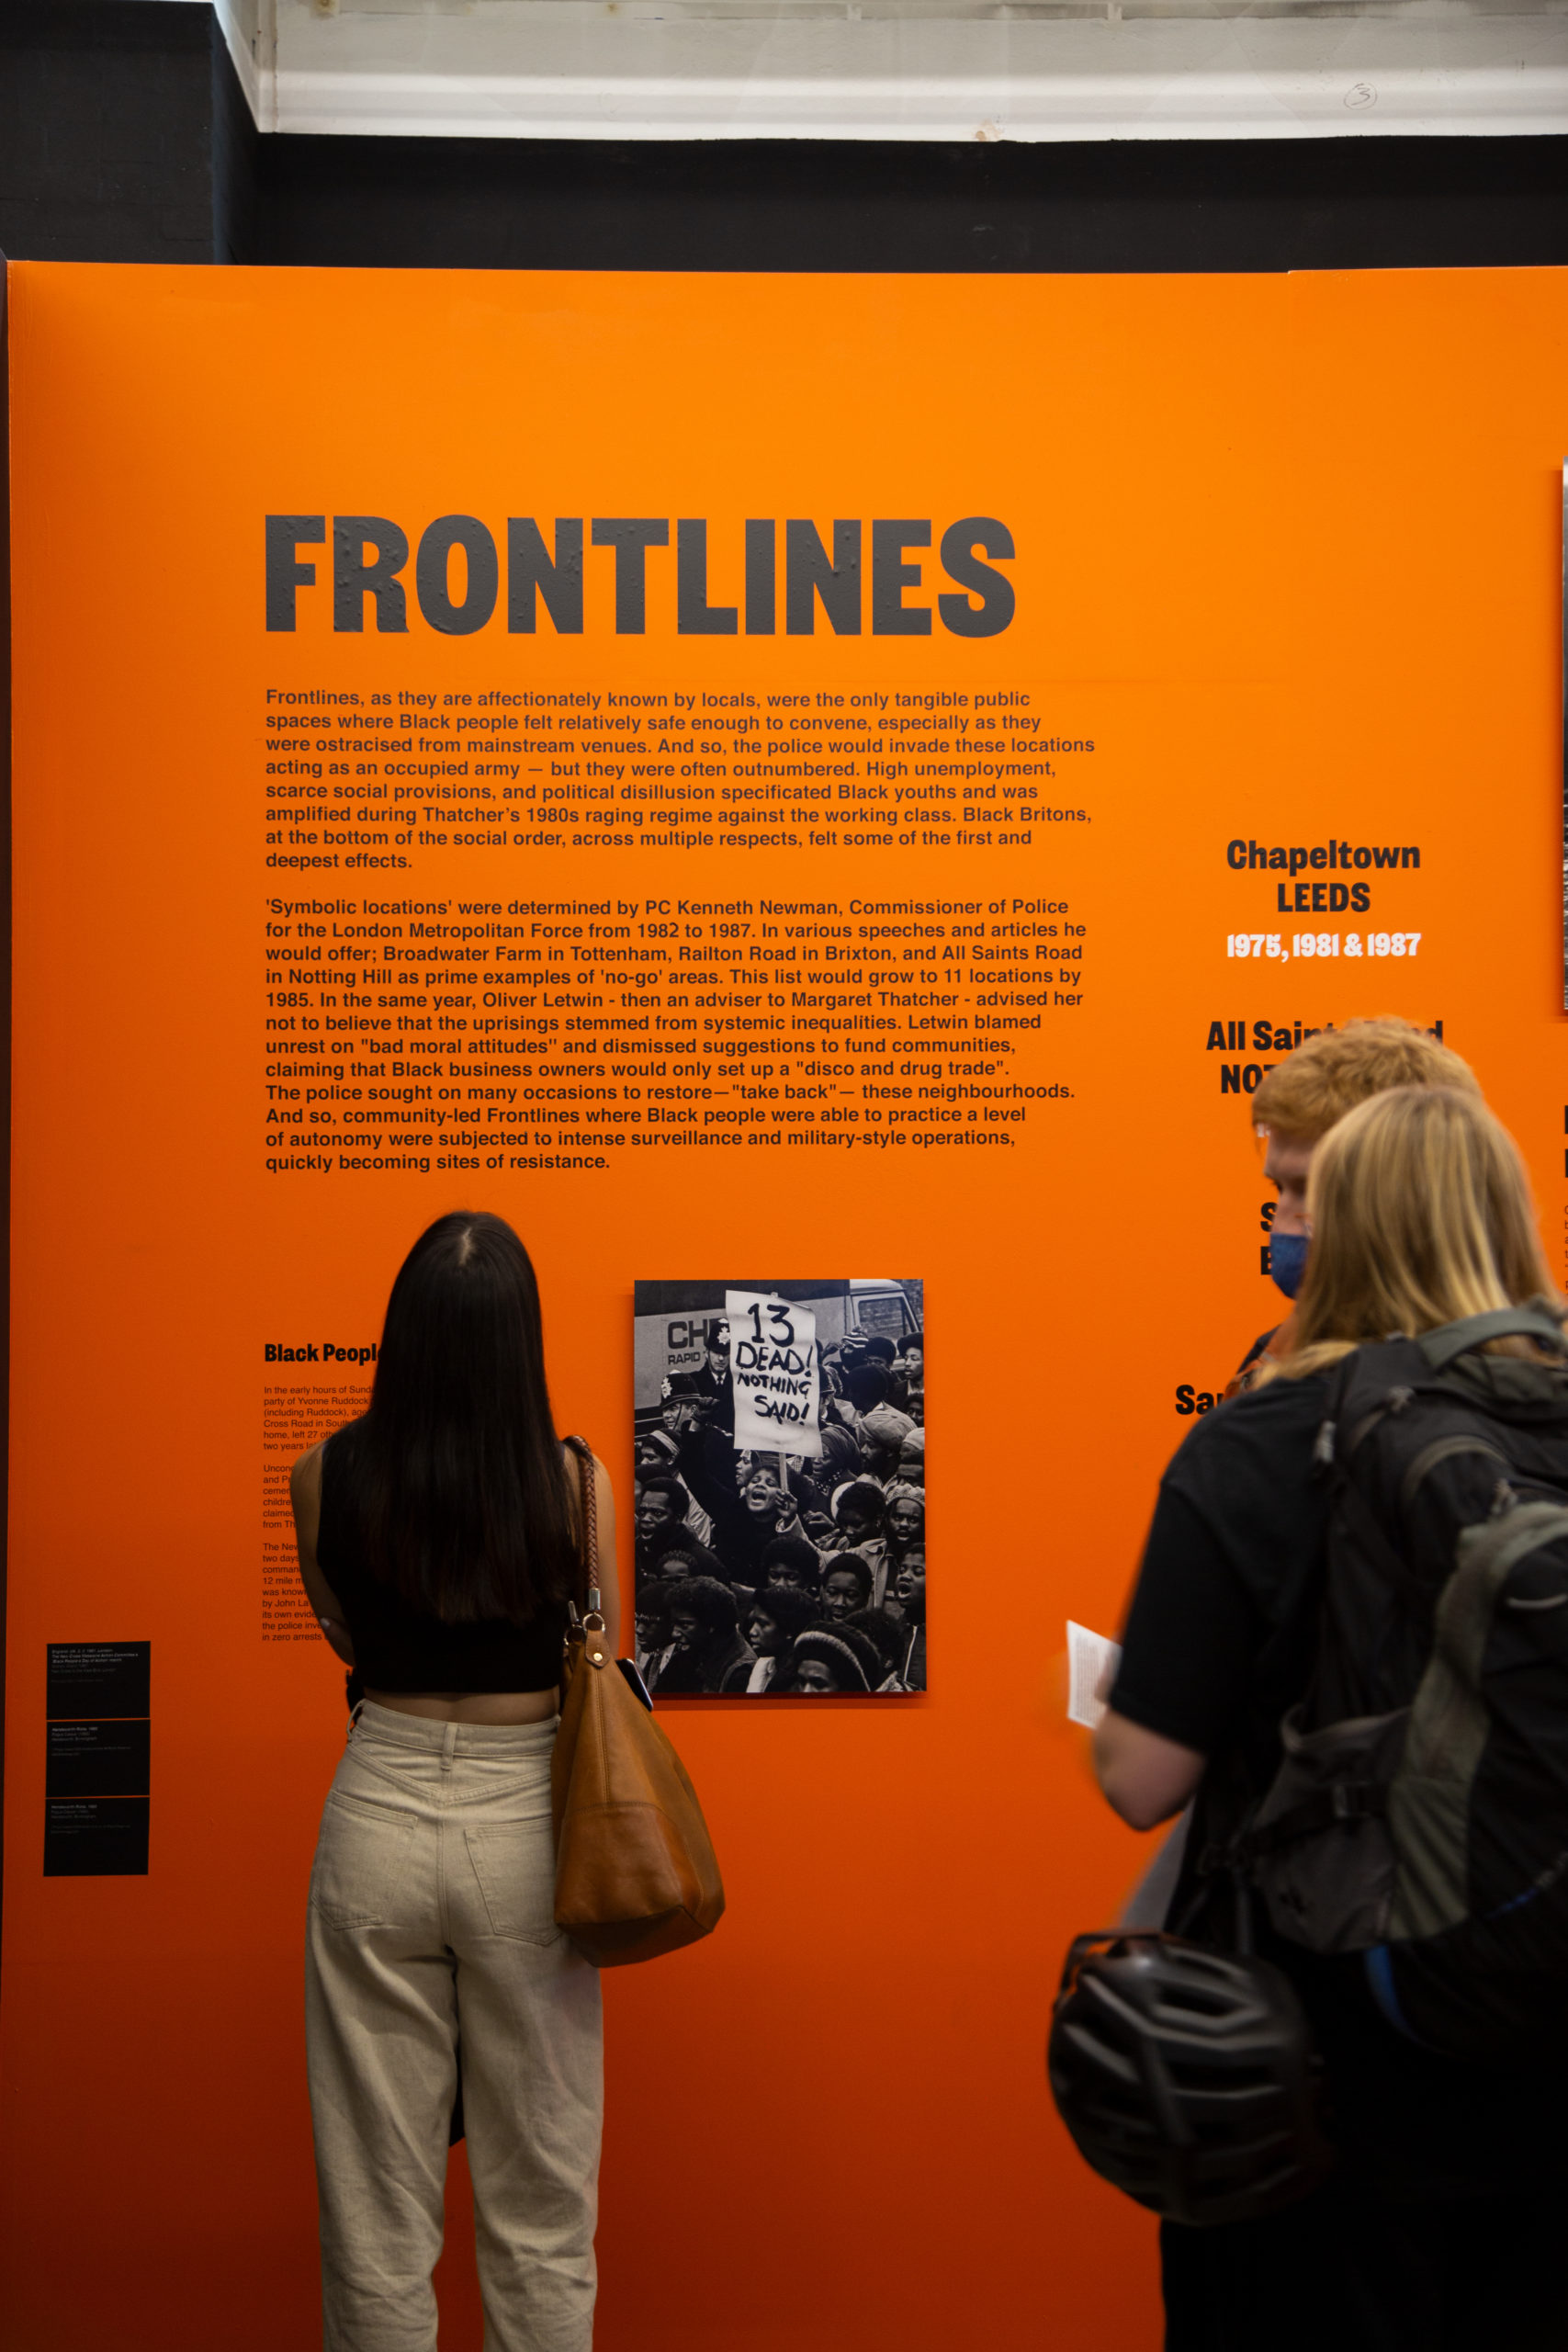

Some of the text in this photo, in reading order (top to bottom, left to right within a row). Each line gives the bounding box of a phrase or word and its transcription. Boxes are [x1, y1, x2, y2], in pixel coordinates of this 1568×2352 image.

[265, 514, 1016, 638] FRONTLINES
[266, 689, 1030, 711] Frontlines, as they are affectionately known by locals, were the only tangible public
[265, 737, 1095, 757] were ostracised from mainstream venues. And so, the police would invade these locations
[265, 783, 1038, 803] scarce social provisions, and political disillusion specificated Black youths and was
[265, 829, 1032, 850] at the bottom of the social order, across multiple respects, felt some of the first and
[1227, 839, 1420, 876] Chapeltown
[1277, 883, 1371, 913] LEEDS
[1227, 933, 1421, 963] 1975, 1981 & 1987
[265, 1014, 1041, 1035] not to believe that the uprisings stemmed from systemic inequalities. Letwin blamed
[1206, 1021, 1246, 1050] All
[265, 1106, 1025, 1127] And so, community-led Frontlines where Black people were able to practice a level
[265, 1153, 610, 1174] quickly becoming sites of resistance.
[748, 1302, 795, 1347] 13
[265, 1343, 381, 1366] Black Peopl
[668, 1351, 701, 1365] RAPID
[735, 1340, 814, 1377] DEAD!
[275, 1385, 288, 1394] the
[290, 1385, 310, 1396] early
[312, 1385, 336, 1394] hours
[339, 1385, 347, 1394] of
[349, 1385, 372, 1394] Sund
[737, 1371, 812, 1398] NOTHING
[264, 1397, 285, 1407] party
[298, 1396, 329, 1405] Yvonne
[332, 1396, 368, 1405] Ruddock
[753, 1395, 809, 1426] SAID!
[264, 1408, 304, 1418] (including
[307, 1408, 349, 1418] Ruddock),
[264, 1430, 290, 1440] home,
[292, 1430, 306, 1439] left
[308, 1430, 318, 1439] 27
[264, 1442, 278, 1450] two
[280, 1442, 304, 1452] years
[263, 1476, 279, 1484] and
[263, 1498, 292, 1506] childre
[263, 1521, 282, 1529] from
[263, 1543, 279, 1551] The
[262, 1600, 273, 1609] by
[262, 1611, 273, 1619] its
[294, 1611, 317, 1619] evide
[262, 1622, 276, 1630] the
[277, 1622, 303, 1631] police
[262, 1633, 270, 1641] in
[293, 1633, 322, 1641] arrests
